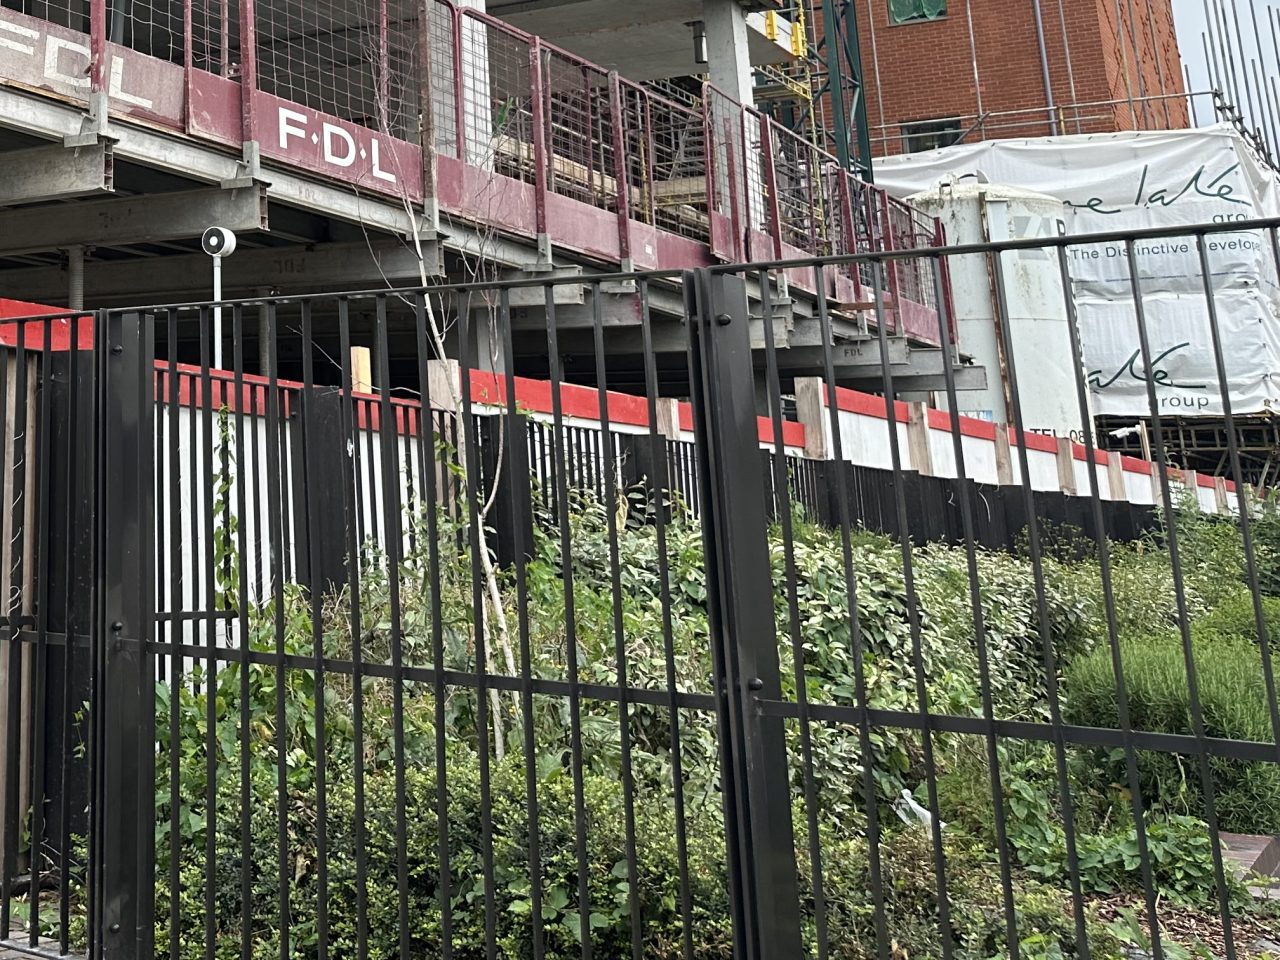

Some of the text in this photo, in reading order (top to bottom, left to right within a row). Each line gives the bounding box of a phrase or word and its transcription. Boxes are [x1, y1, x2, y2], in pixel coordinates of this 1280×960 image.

[1071, 247, 1099, 260] The
[1106, 241, 1189, 257] Disinctive
[1153, 396, 1209, 410] roup
